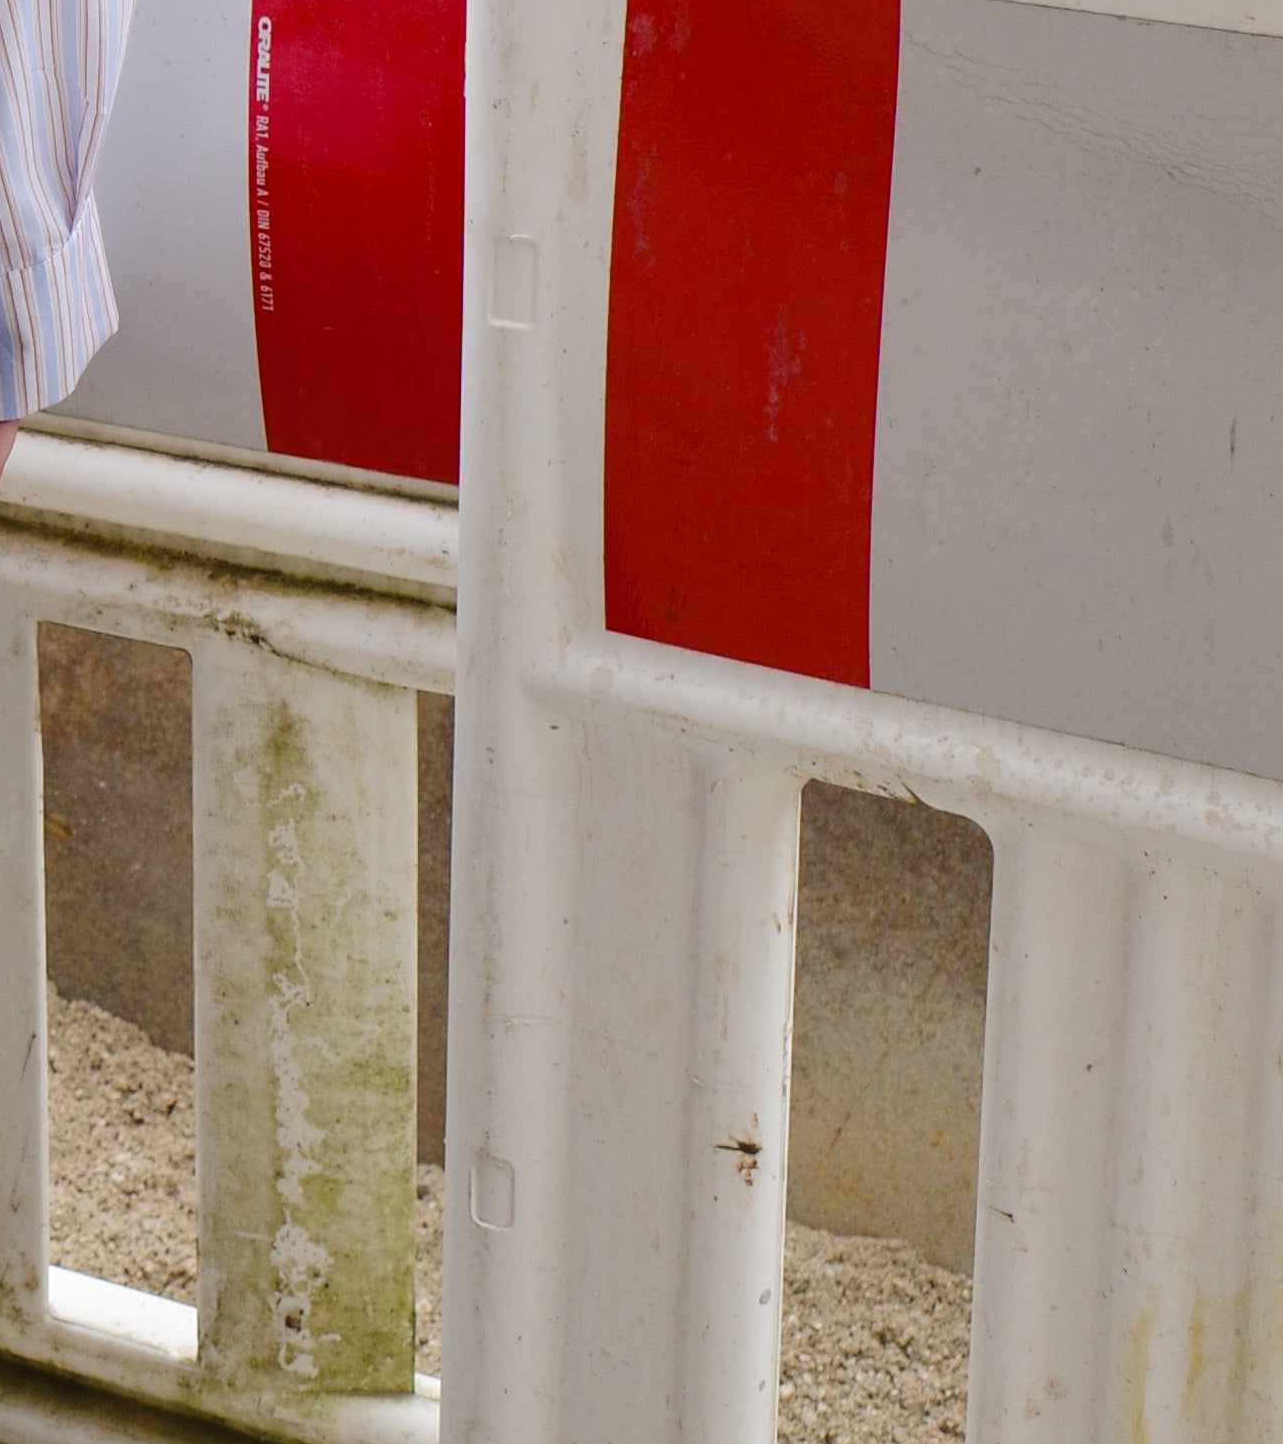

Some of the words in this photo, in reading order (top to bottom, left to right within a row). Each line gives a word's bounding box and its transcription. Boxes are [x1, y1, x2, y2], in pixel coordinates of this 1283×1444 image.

[256, 145, 270, 186] Aufbau
[256, 188, 270, 197] A
[257, 210, 271, 230] DIN
[258, 232, 272, 268] 67520
[260, 271, 273, 281] &
[260, 285, 275, 311] 6171
